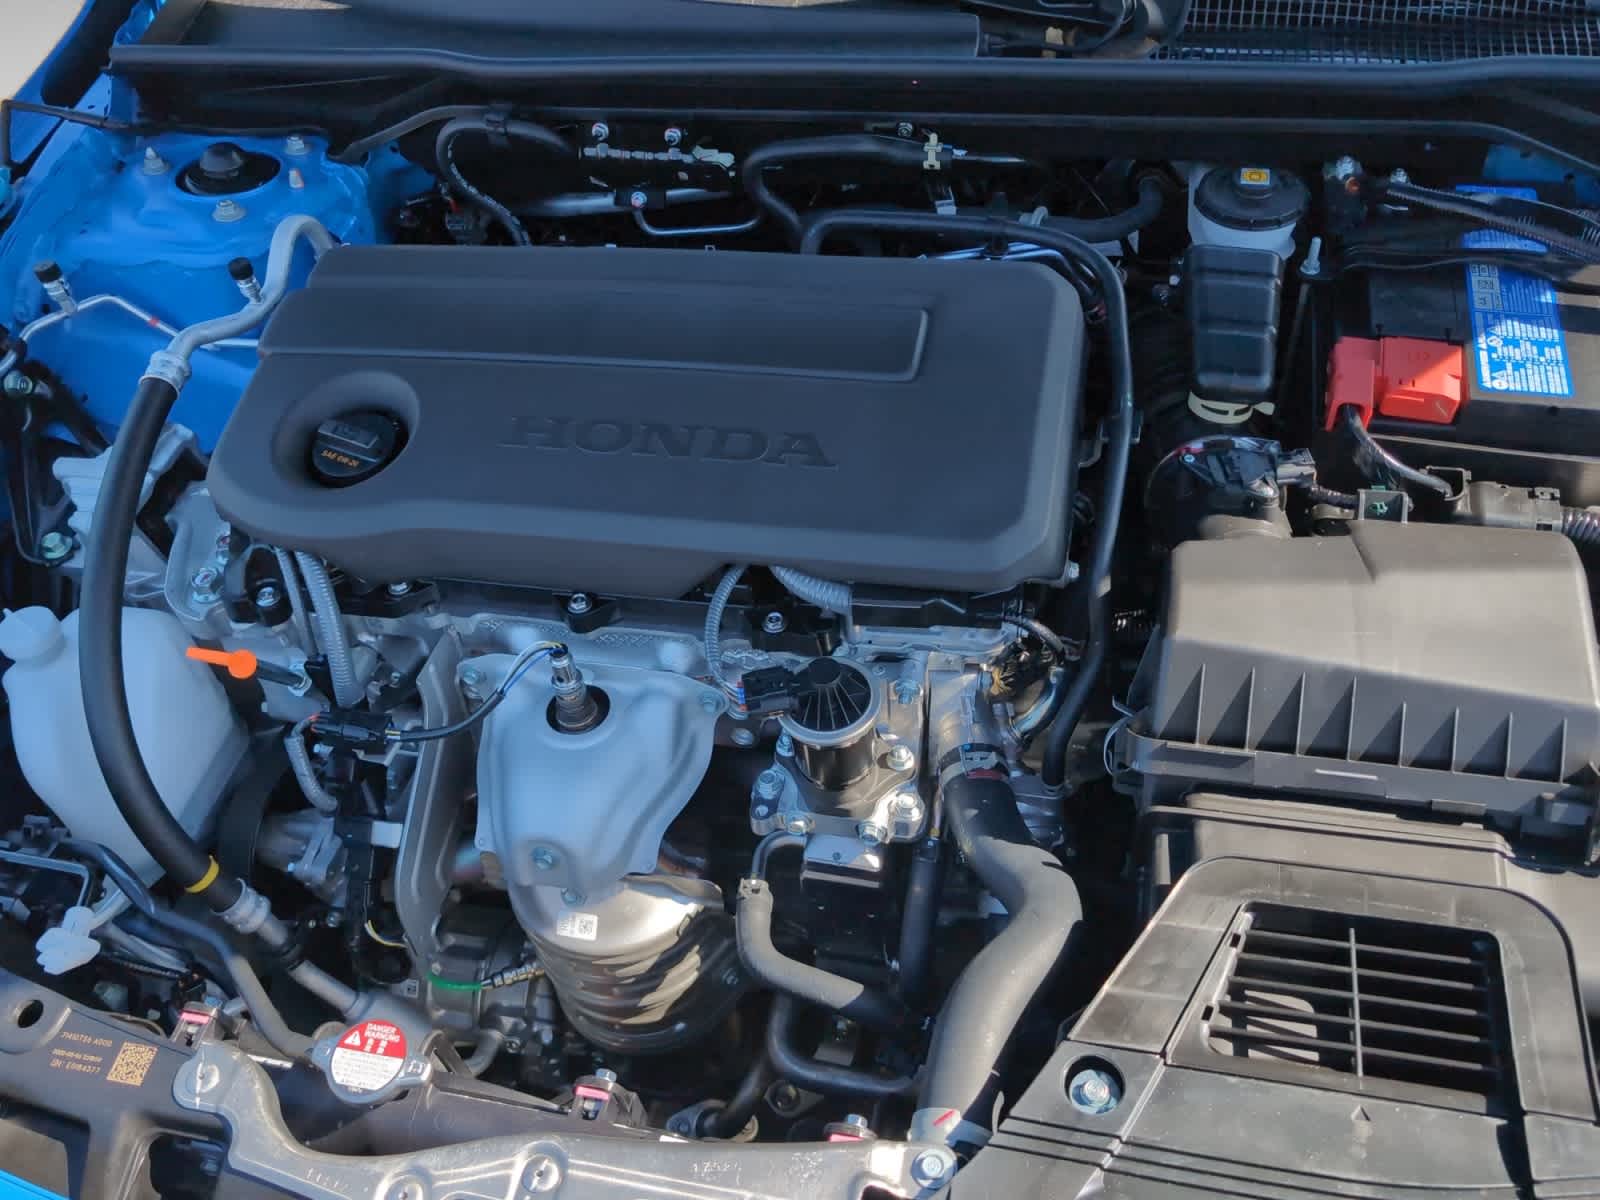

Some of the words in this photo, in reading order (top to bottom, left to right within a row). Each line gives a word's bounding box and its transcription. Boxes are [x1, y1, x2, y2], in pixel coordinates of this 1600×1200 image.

[497, 415, 839, 472] HONDA
[367, 1022, 398, 1034] DANGER
[364, 1030, 401, 1043] WARNING
